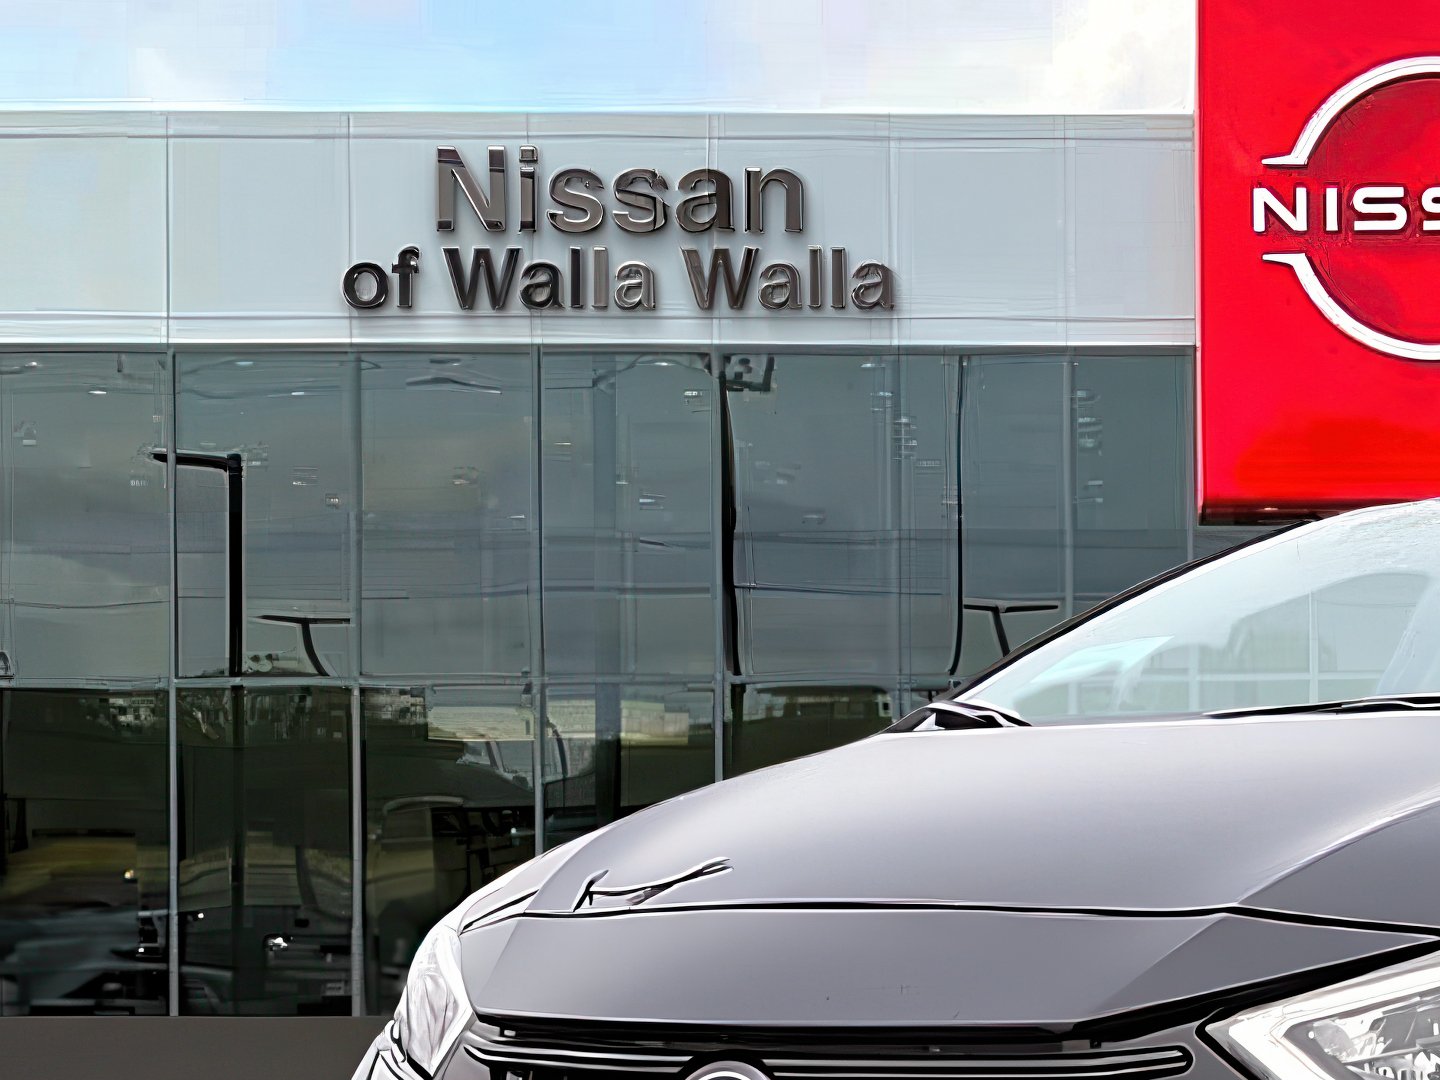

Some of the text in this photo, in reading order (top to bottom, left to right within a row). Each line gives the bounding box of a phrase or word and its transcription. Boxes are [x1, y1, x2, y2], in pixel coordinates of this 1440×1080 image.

[435, 145, 805, 233] Nissan
[342, 245, 896, 310] of Walla Walla
